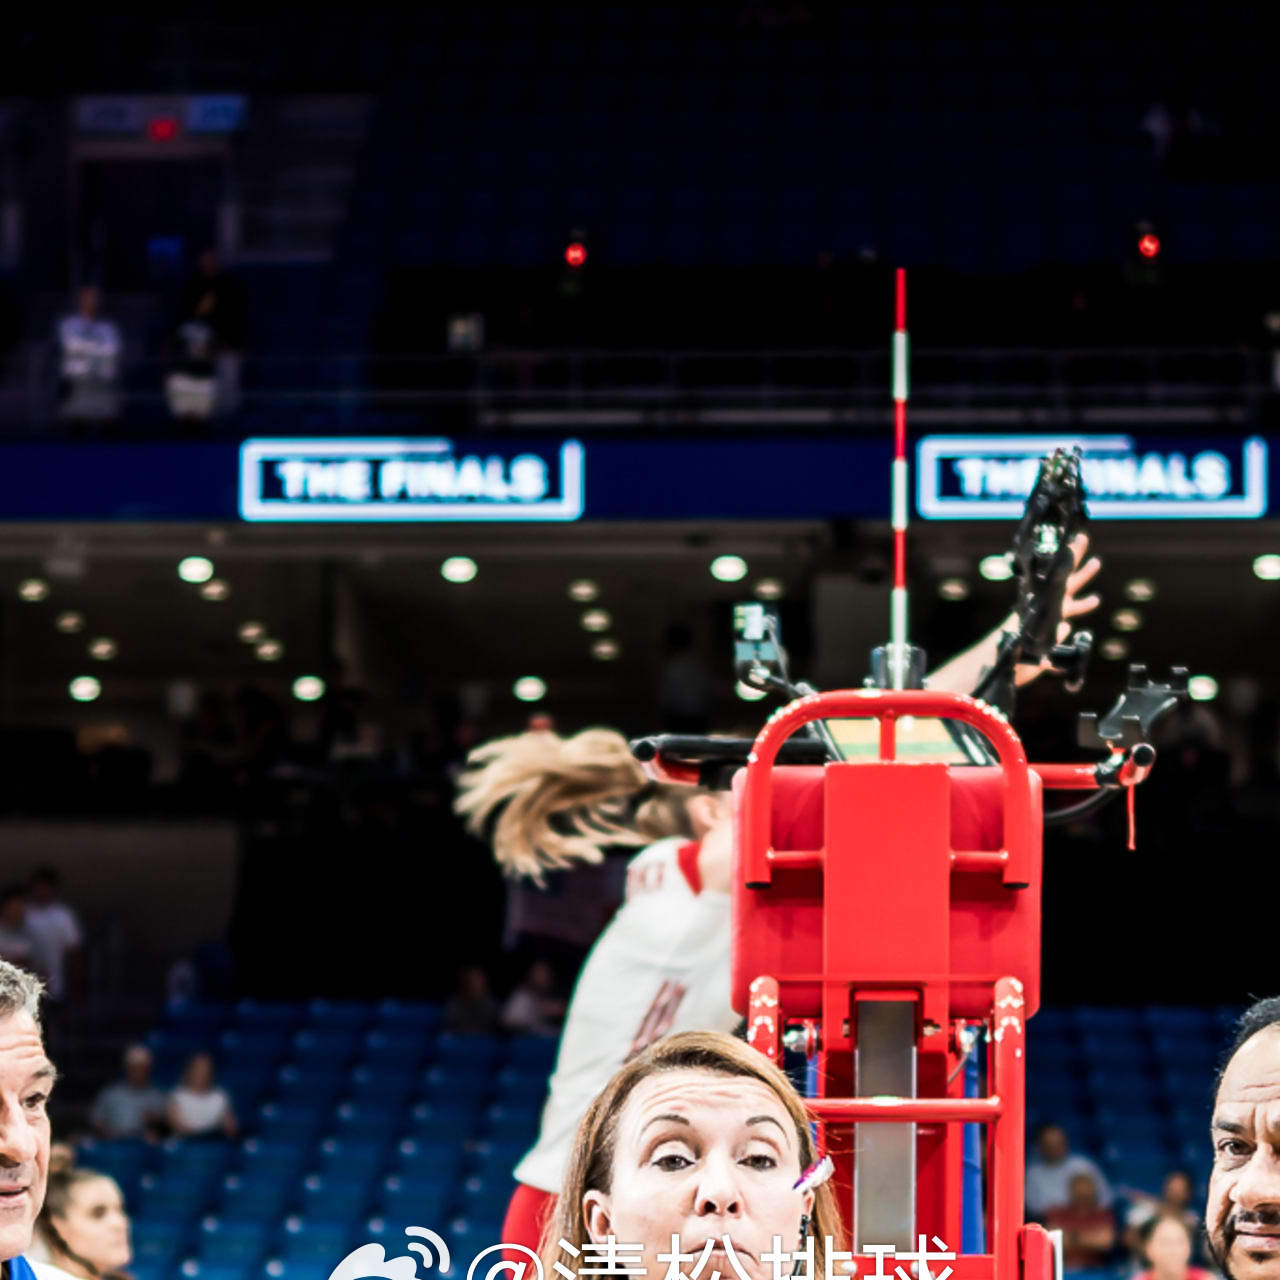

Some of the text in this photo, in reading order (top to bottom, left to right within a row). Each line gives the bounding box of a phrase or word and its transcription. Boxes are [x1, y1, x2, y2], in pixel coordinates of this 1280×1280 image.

[277, 454, 547, 502] THE FINALS
[1079, 451, 1231, 499] INALS
